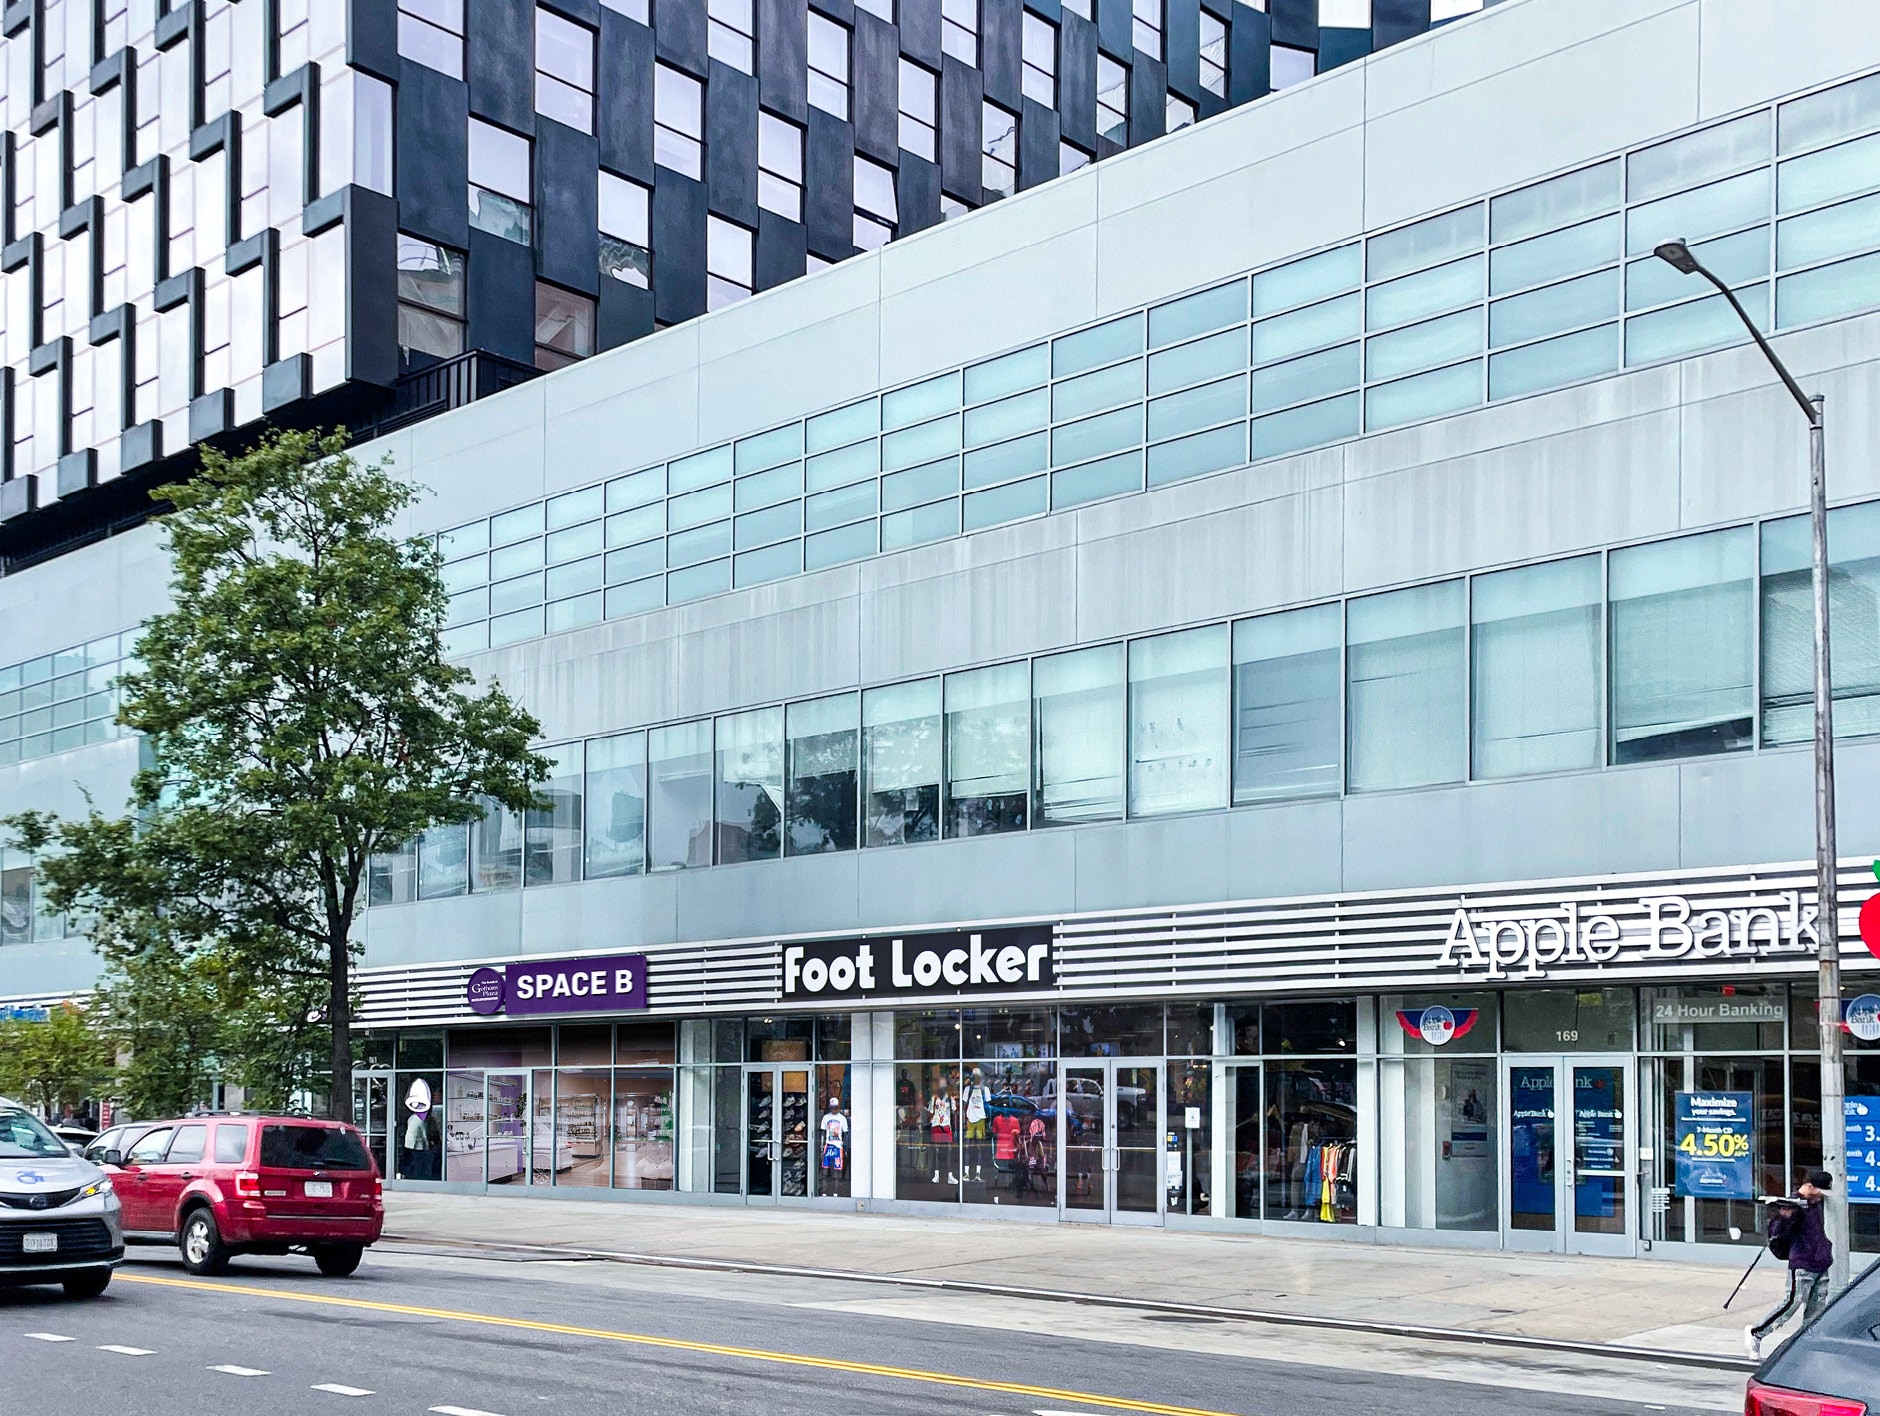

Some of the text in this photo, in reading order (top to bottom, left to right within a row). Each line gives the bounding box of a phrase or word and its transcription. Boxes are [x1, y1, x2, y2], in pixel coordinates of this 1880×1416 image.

[1435, 891, 1821, 980] Apple Bank
[785, 934, 1048, 993] Foot Locker
[471, 983, 499, 994] Gotham
[517, 969, 633, 999] SPACE B
[1656, 1003, 1784, 1020] 24 Hour Banking
[1555, 1030, 1578, 1043] 169
[1690, 1096, 1738, 1108] Maximize
[1679, 1133, 1749, 1157] 4.50%
